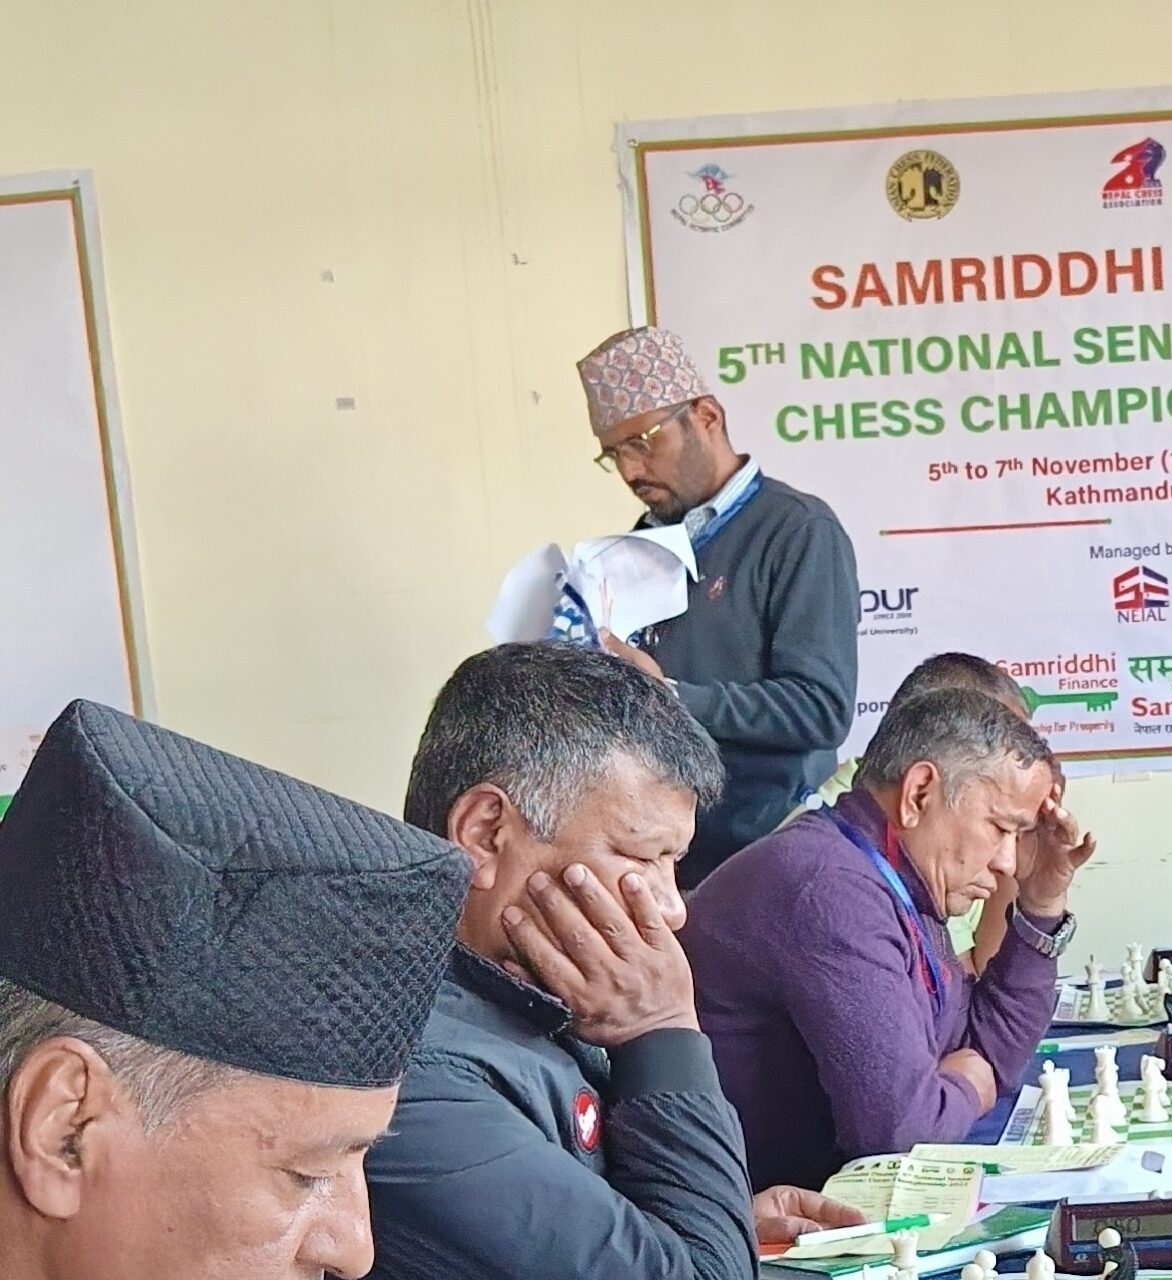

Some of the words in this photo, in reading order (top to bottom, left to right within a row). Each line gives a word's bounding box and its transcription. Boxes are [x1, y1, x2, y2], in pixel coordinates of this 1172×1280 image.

[811, 245, 1164, 310] SAMRIDDHI
[717, 342, 786, 384] 5TH
[800, 330, 1061, 380] NATIONAL
[775, 398, 945, 442] CHESS
[928, 459, 959, 482] 5th
[965, 461, 988, 480] to
[995, 456, 1023, 479] 7th
[1032, 451, 1154, 477] November
[1090, 543, 1160, 560] Managed
[858, 587, 919, 622] pur
[1058, 676, 1119, 690] Finance
[857, 701, 891, 717] pon
